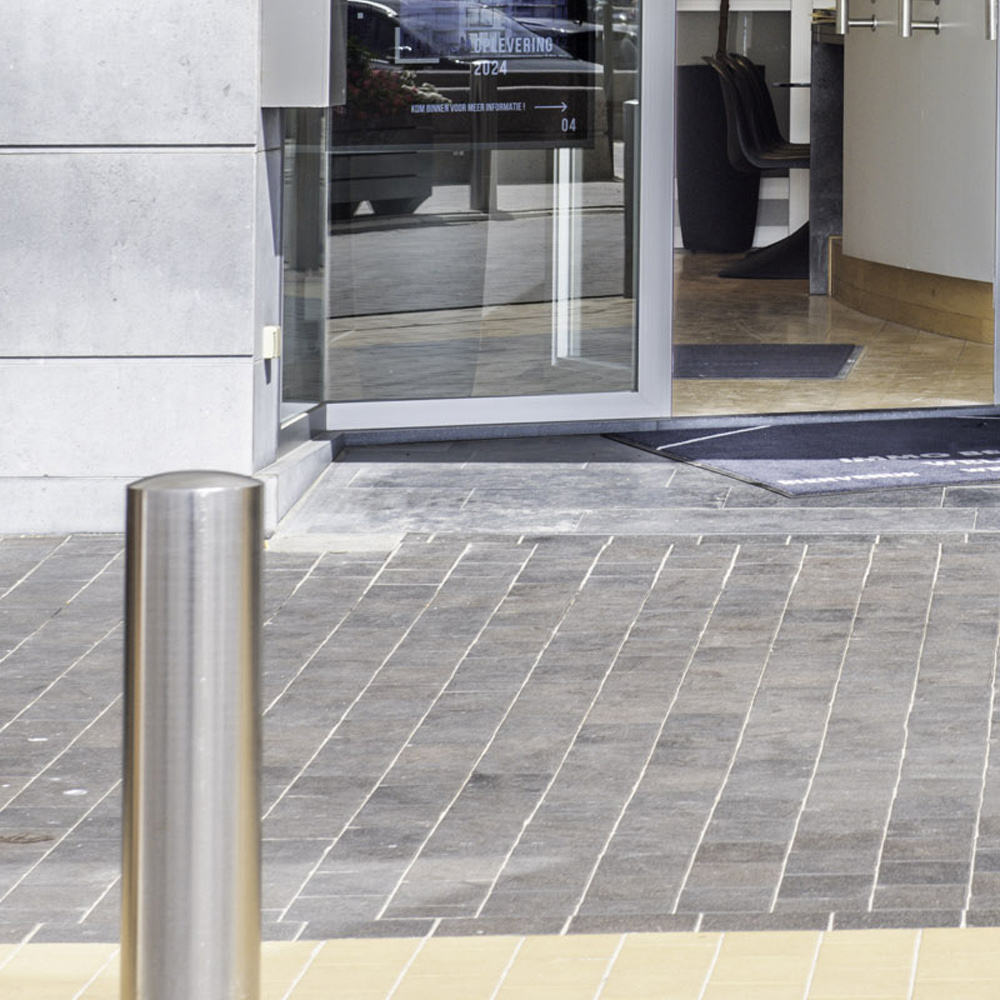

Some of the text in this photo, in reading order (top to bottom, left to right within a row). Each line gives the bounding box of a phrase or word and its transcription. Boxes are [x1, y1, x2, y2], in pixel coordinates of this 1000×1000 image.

[474, 37, 553, 53] OPLEVERING
[474, 60, 508, 75] 2024
[411, 104, 425, 113] KOM
[426, 104, 449, 113] BINNEN
[450, 103, 466, 112] VOOR
[468, 103, 484, 112] MEER
[485, 102, 522, 111] INFORMATIE
[561, 118, 577, 132] 04
